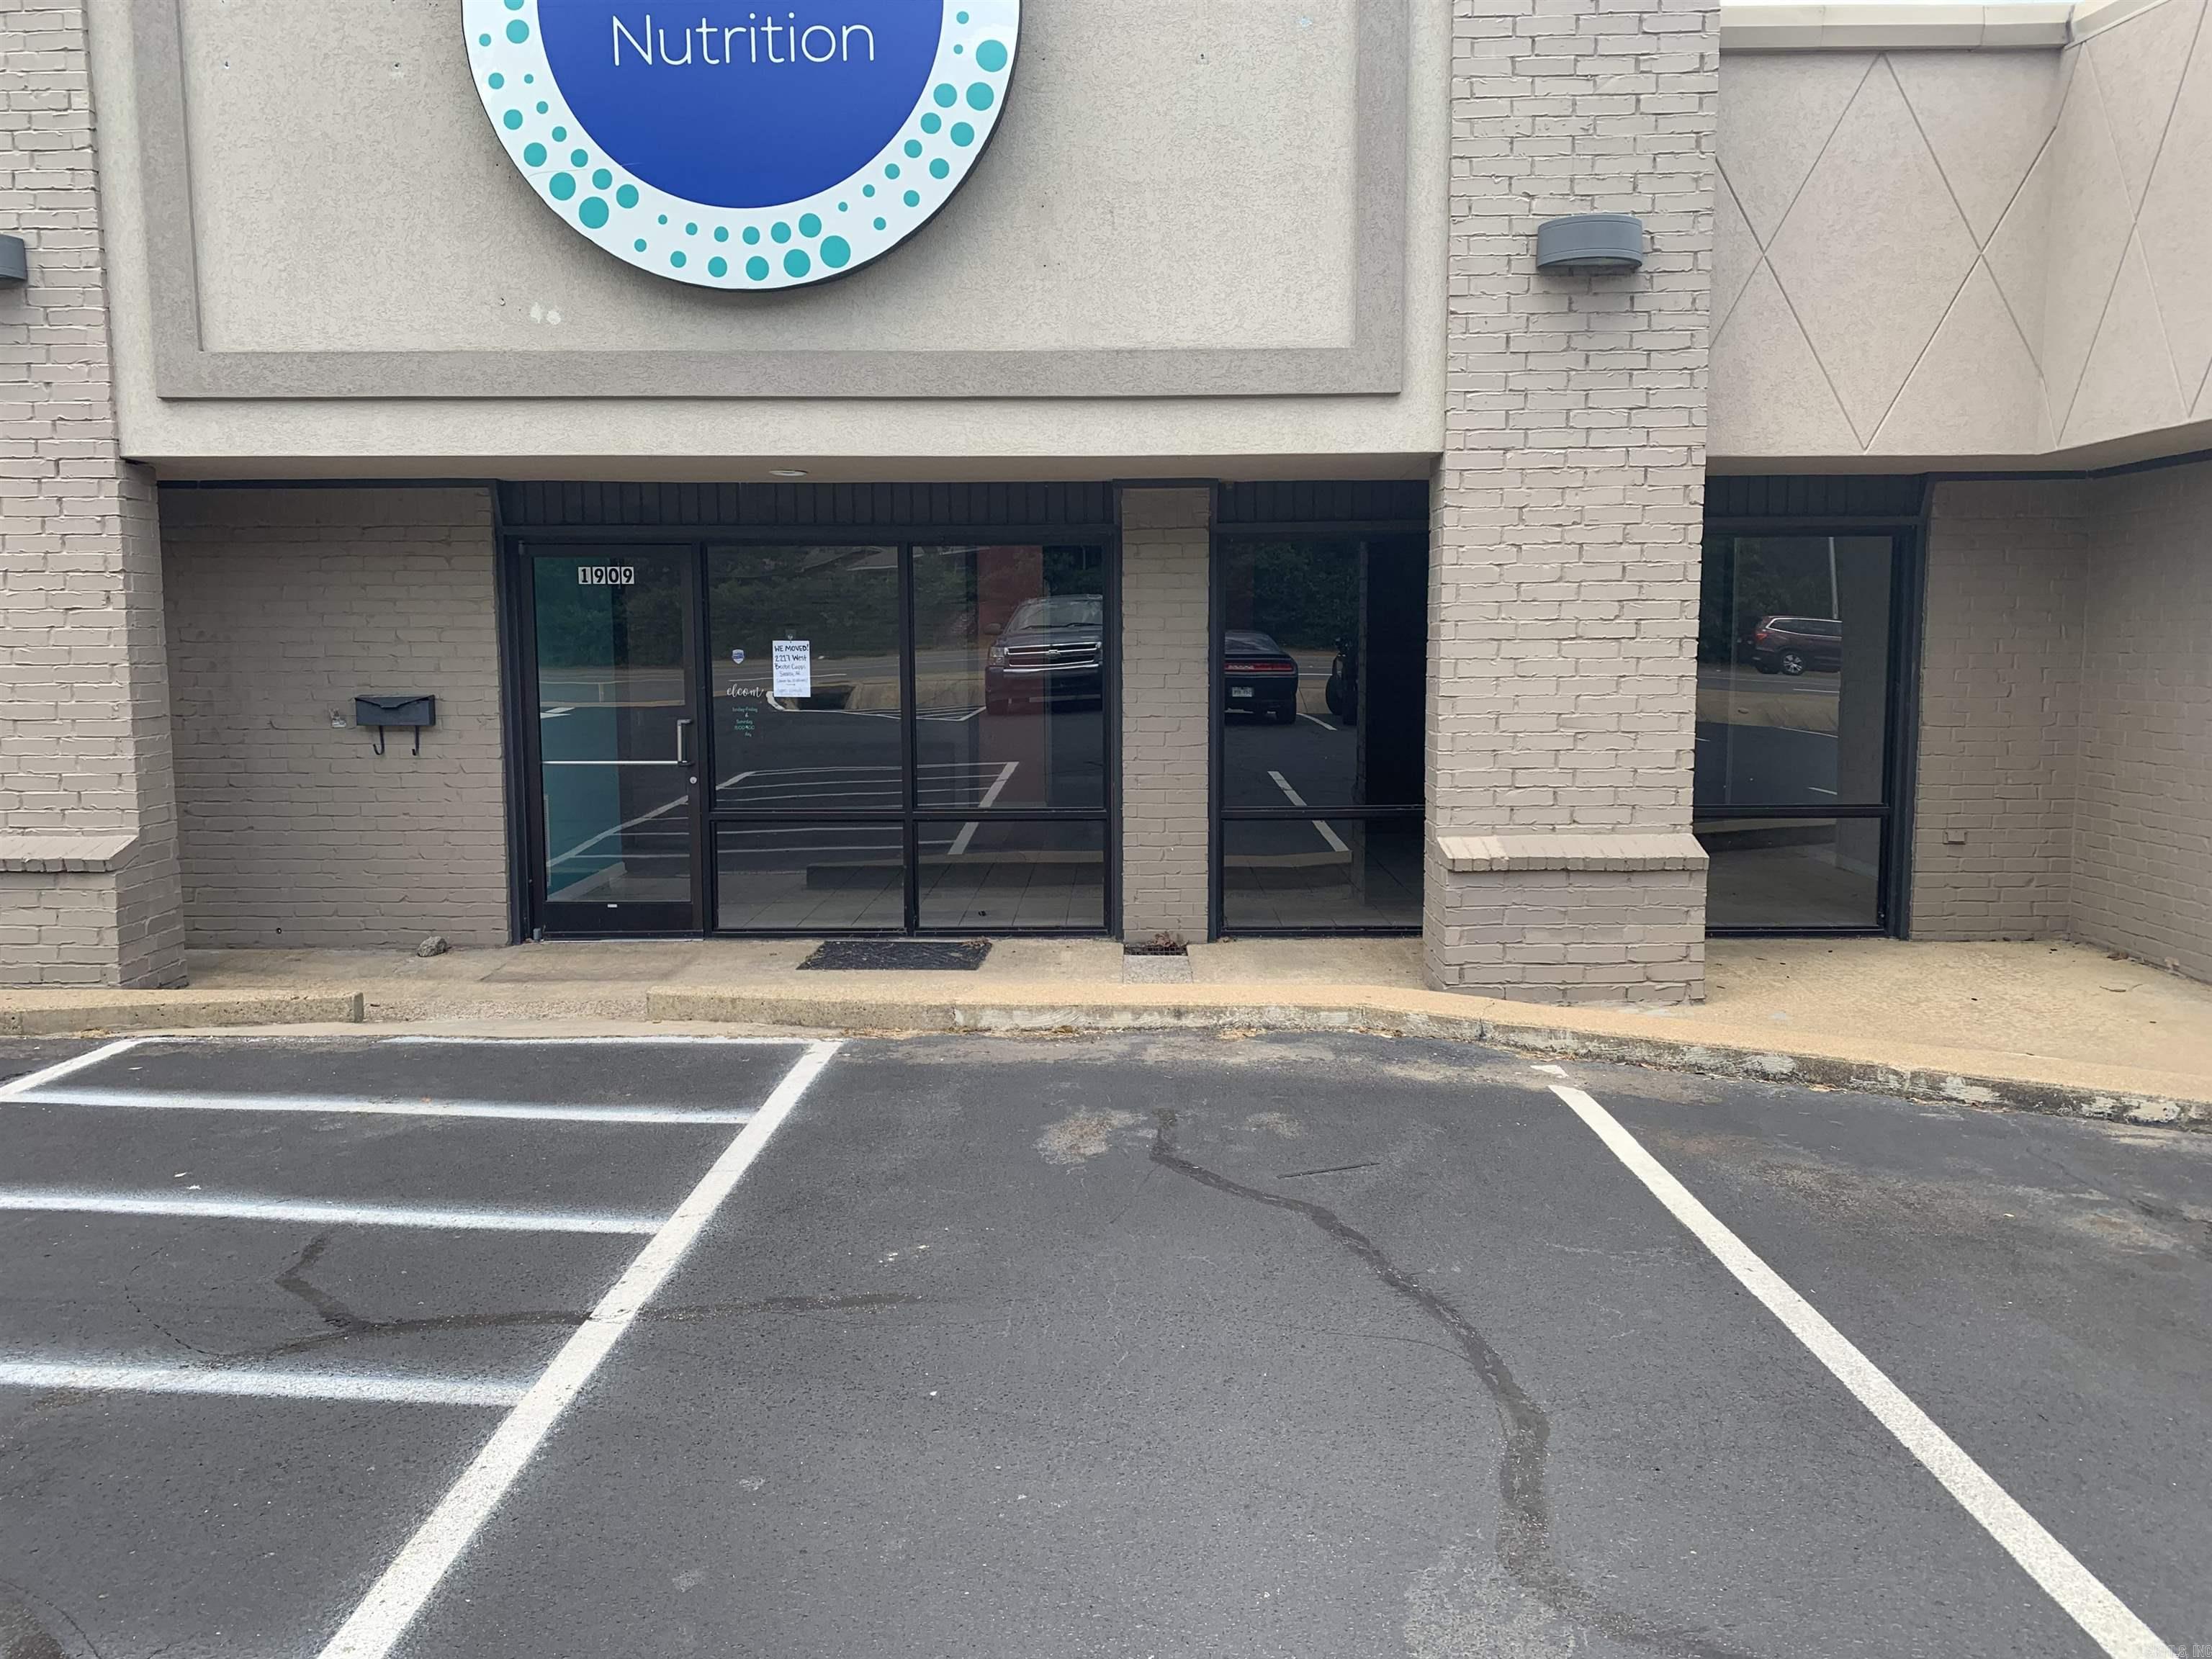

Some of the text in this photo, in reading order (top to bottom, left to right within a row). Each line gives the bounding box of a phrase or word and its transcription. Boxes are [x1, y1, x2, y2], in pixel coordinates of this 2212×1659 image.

[612, 12, 875, 66] Nutrition
[581, 567, 633, 583] 1909
[785, 642, 809, 652] MOVED!
